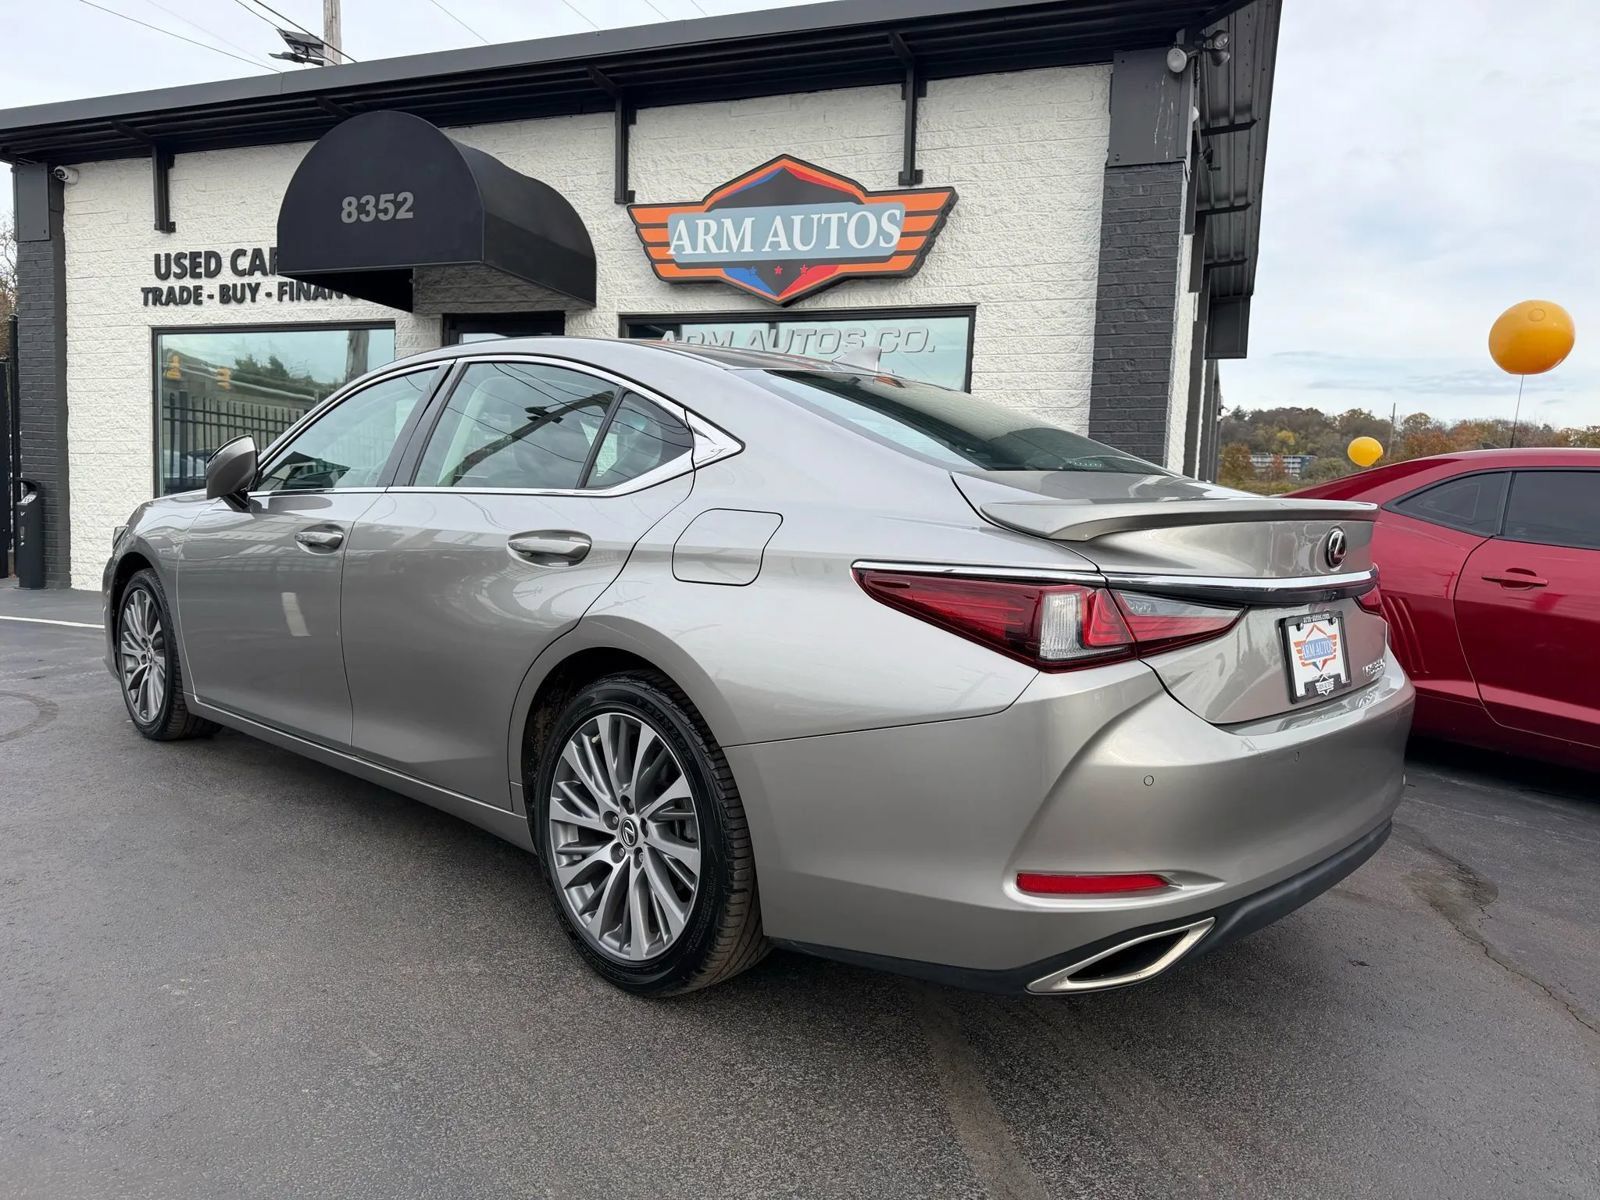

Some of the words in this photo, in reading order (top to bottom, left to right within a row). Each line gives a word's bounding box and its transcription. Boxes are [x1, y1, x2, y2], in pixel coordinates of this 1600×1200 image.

[340, 191, 415, 224] 8352
[666, 216, 756, 255] ARM
[763, 209, 902, 250] AUTOS
[153, 250, 222, 281] USED
[141, 284, 204, 307] TRADE
[218, 282, 261, 305] BUY
[277, 281, 358, 302] FINA
[745, 328, 867, 355] AUTOS
[872, 326, 936, 353] CO.
